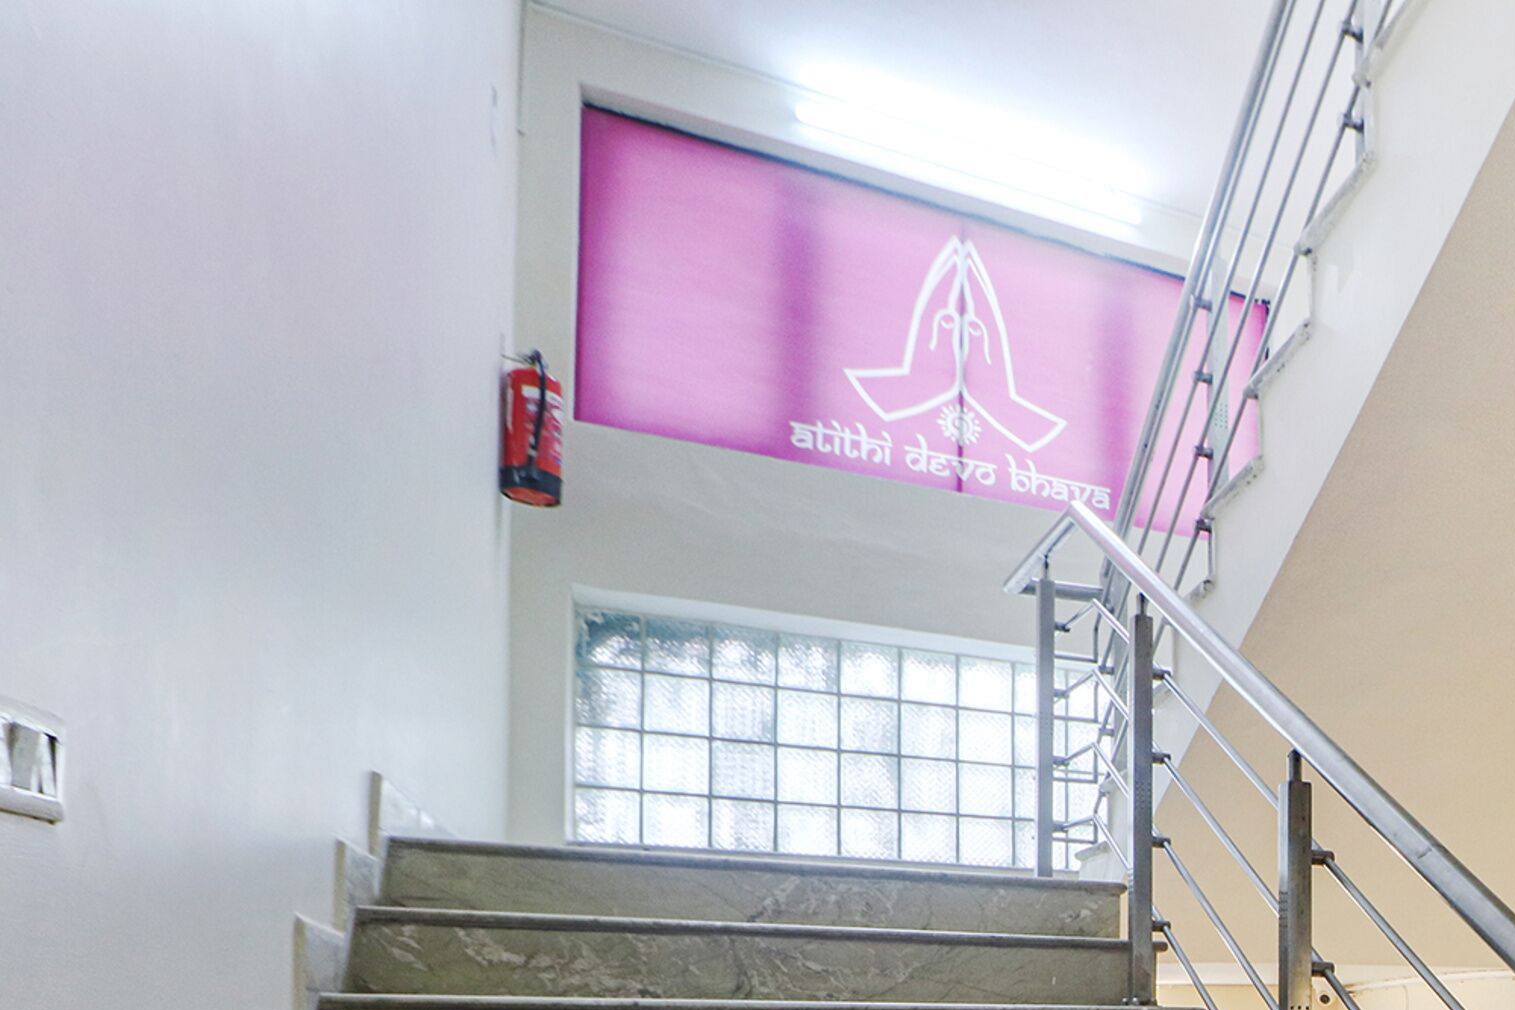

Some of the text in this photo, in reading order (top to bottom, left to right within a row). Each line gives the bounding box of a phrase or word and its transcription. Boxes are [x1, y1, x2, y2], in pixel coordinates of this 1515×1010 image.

[789, 419, 1111, 510] atithi devo bhava
